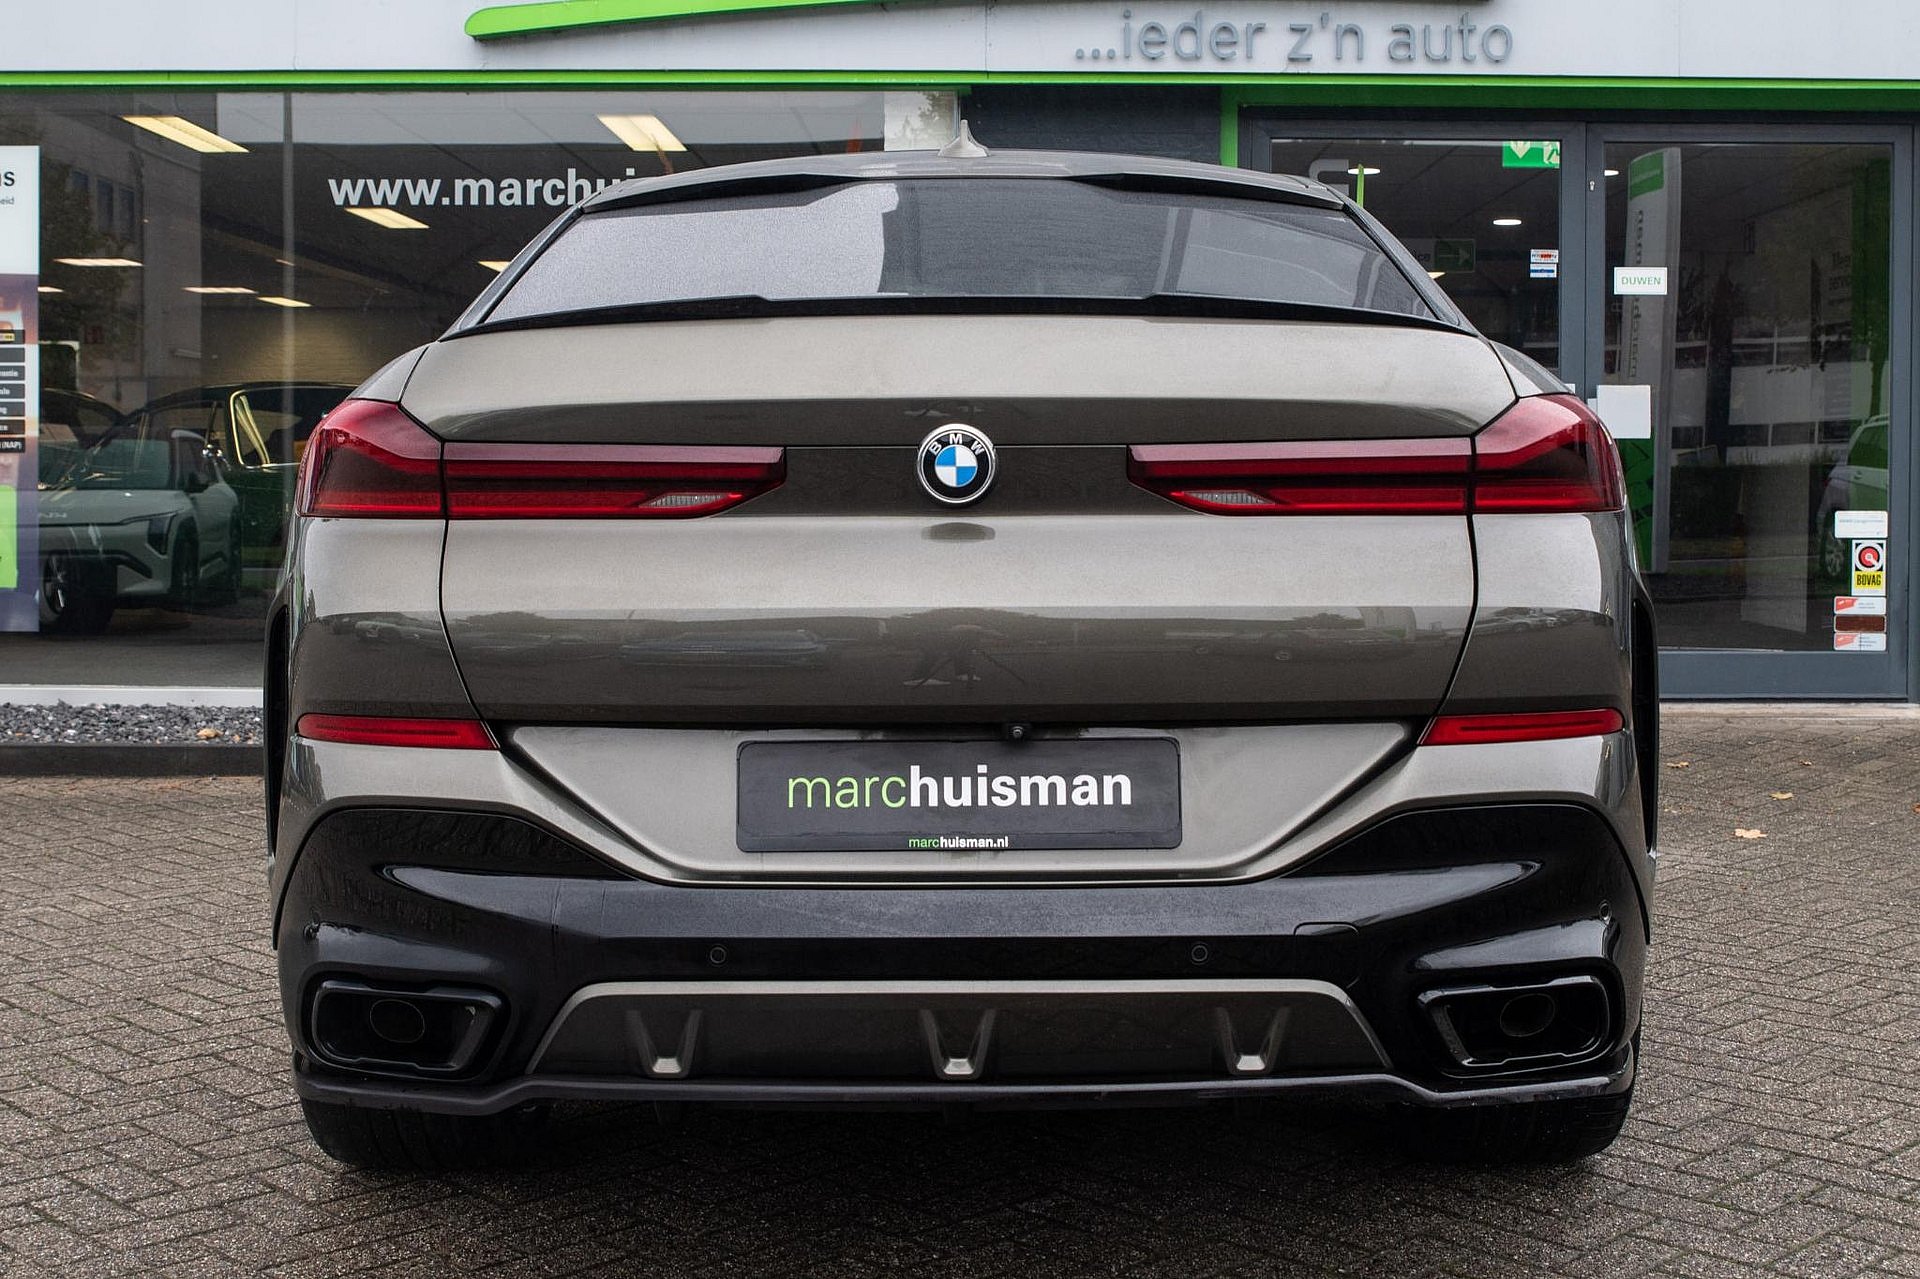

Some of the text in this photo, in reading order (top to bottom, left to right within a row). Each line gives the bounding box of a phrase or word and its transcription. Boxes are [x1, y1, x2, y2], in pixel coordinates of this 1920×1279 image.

[1287, 12, 1365, 63] z'n
[1387, 10, 1513, 63] auto
[328, 168, 636, 206] www.march
[1621, 276, 1662, 286] DUWEN
[928, 433, 985, 456] BMW
[1856, 573, 1882, 586] BOVAG
[787, 765, 1132, 809] marchuisman
[908, 836, 1009, 849] marchuisman.nl
